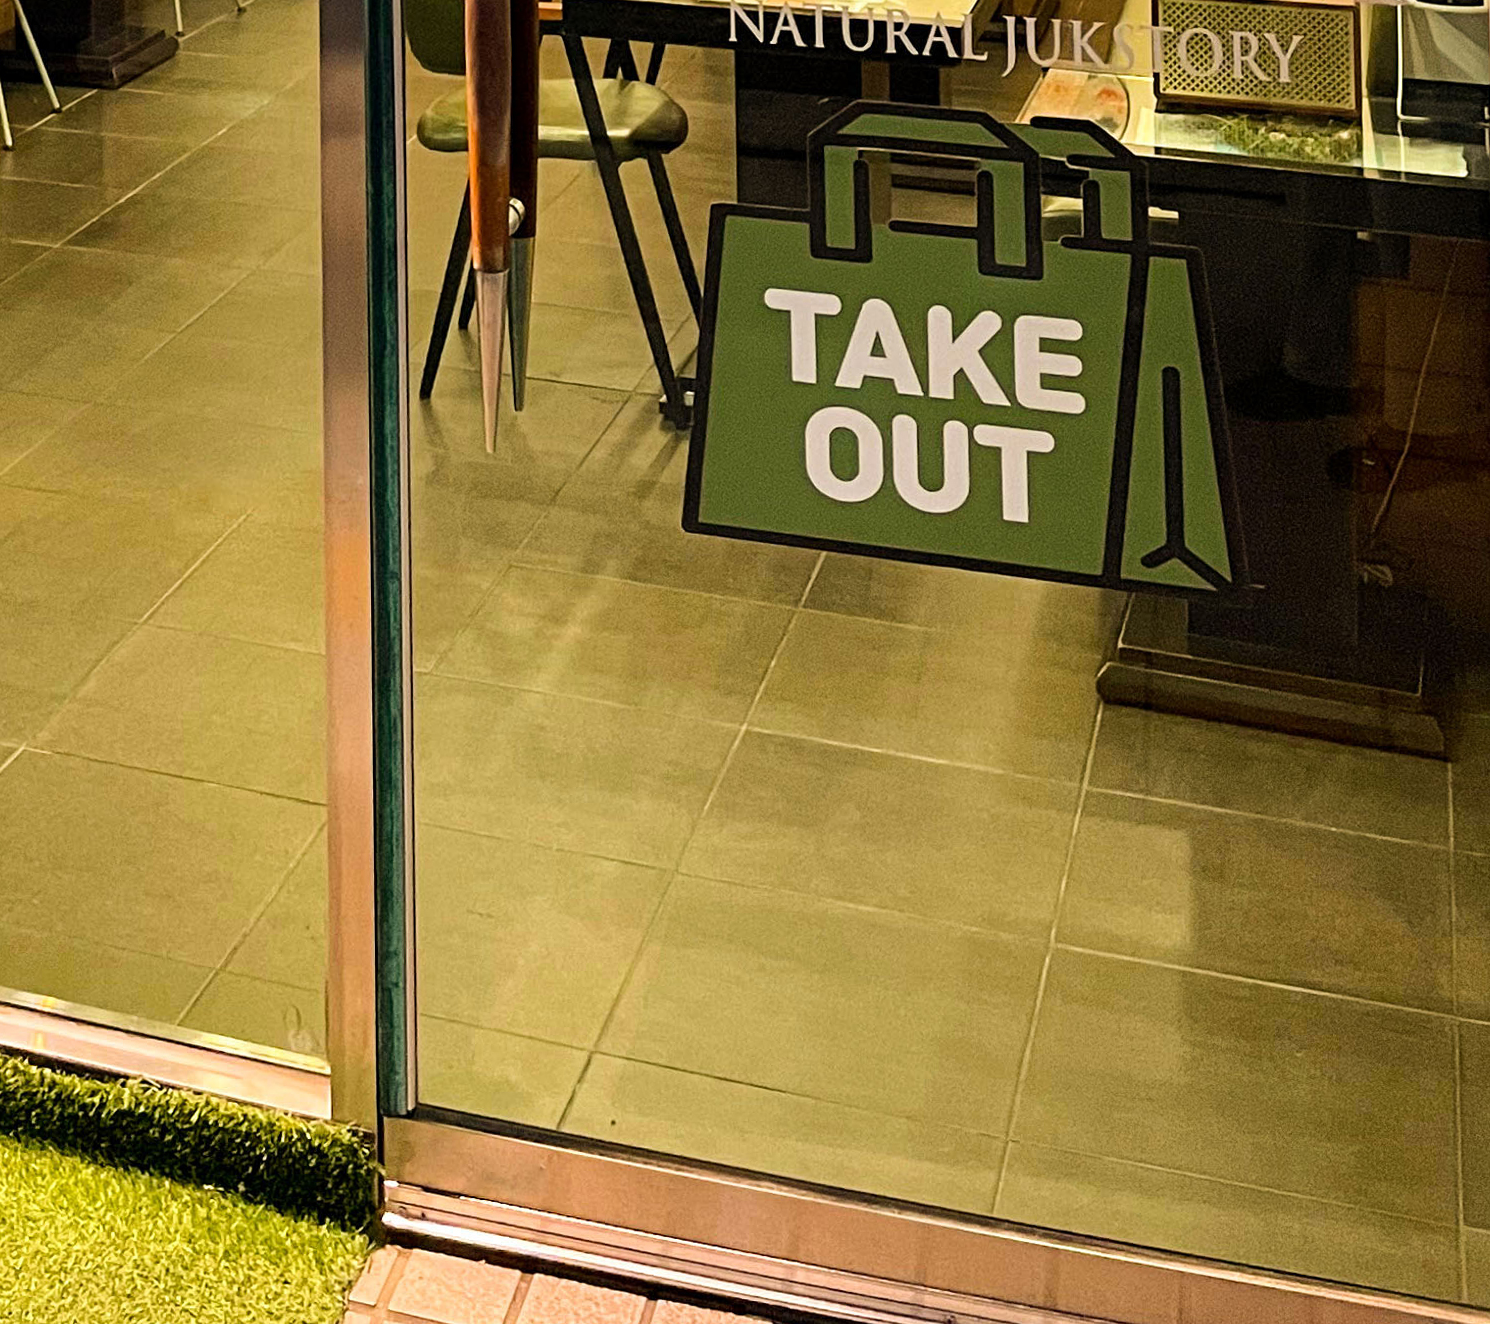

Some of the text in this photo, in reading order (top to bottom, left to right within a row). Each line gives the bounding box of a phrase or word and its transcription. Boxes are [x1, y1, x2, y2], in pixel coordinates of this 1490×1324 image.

[999, 11, 1304, 85] JUKSTORY
[763, 287, 1087, 415] TAKE
[804, 405, 1055, 524] OUT
